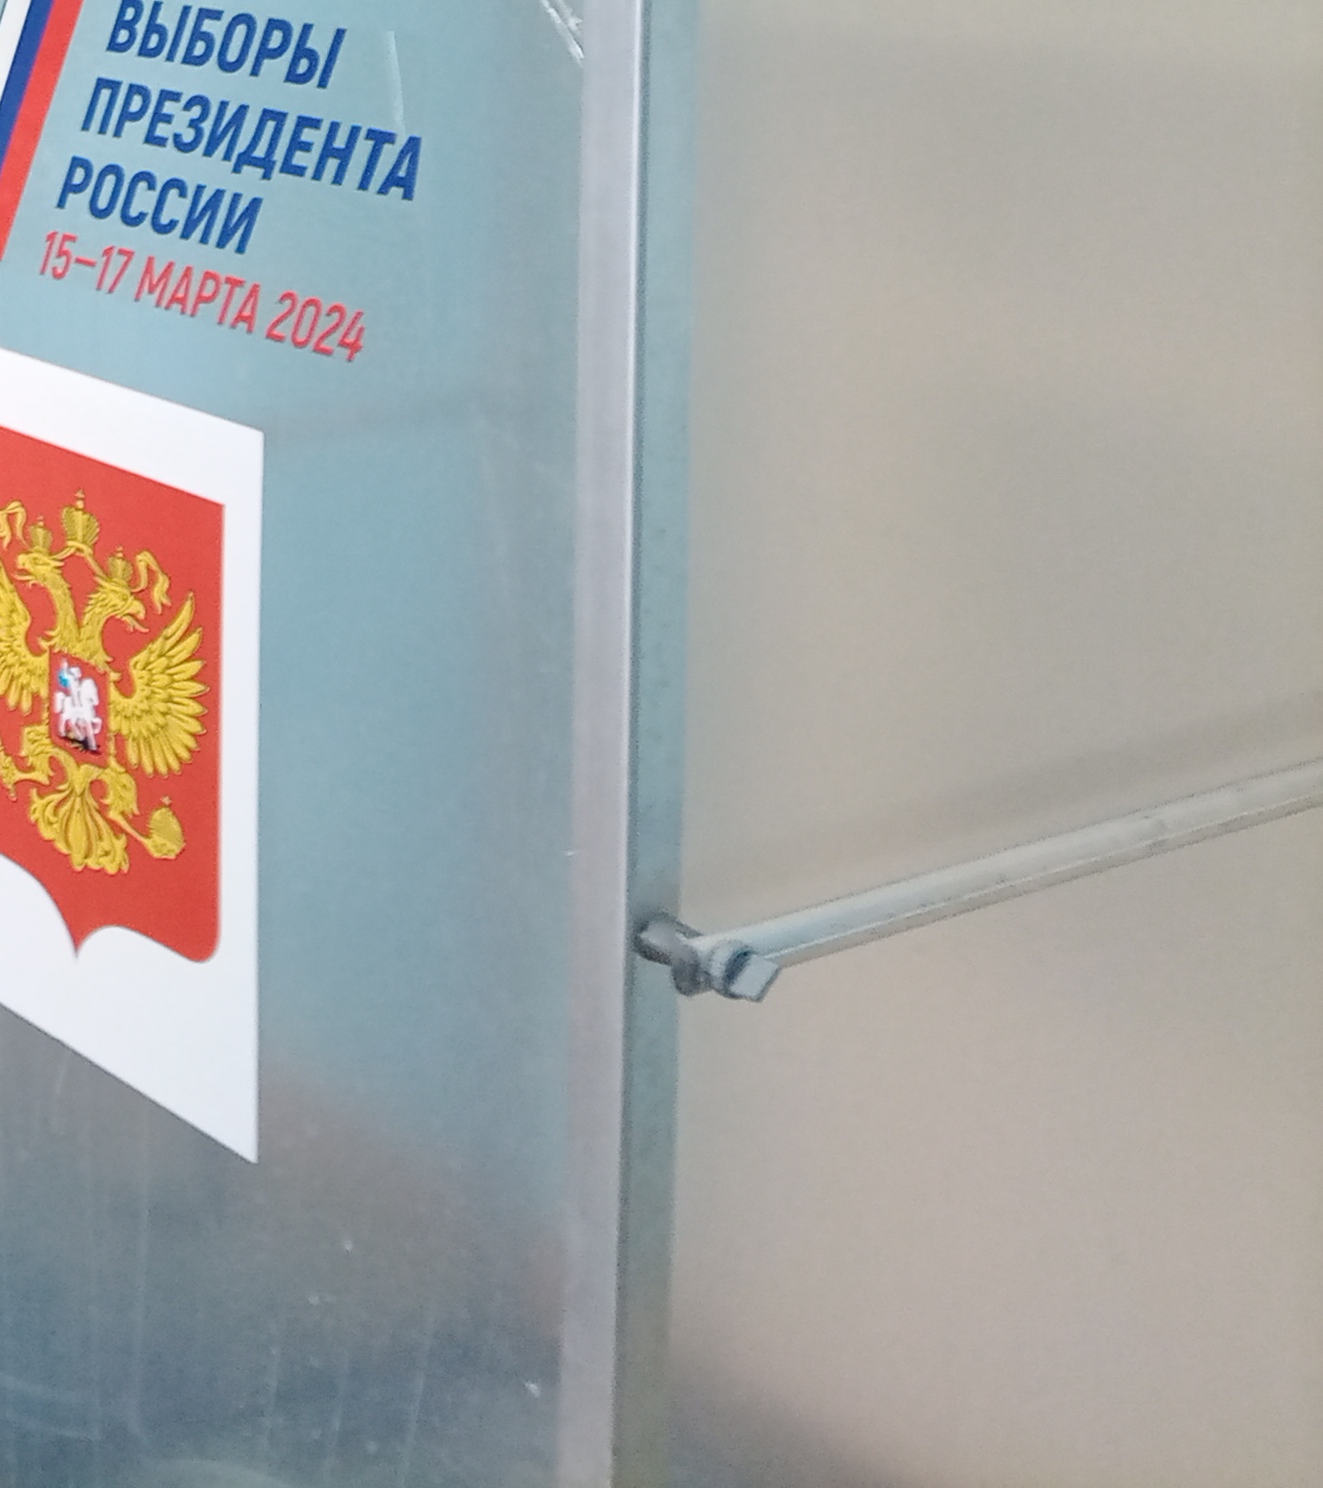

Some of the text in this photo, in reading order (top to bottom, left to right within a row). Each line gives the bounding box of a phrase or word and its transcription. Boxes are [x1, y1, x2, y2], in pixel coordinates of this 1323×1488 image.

[80, 76, 423, 202] ПРЕЗИДЕНТА
[55, 155, 263, 255] РОССИИ
[134, 254, 260, 335] МАРТА
[264, 289, 367, 363] 2024
